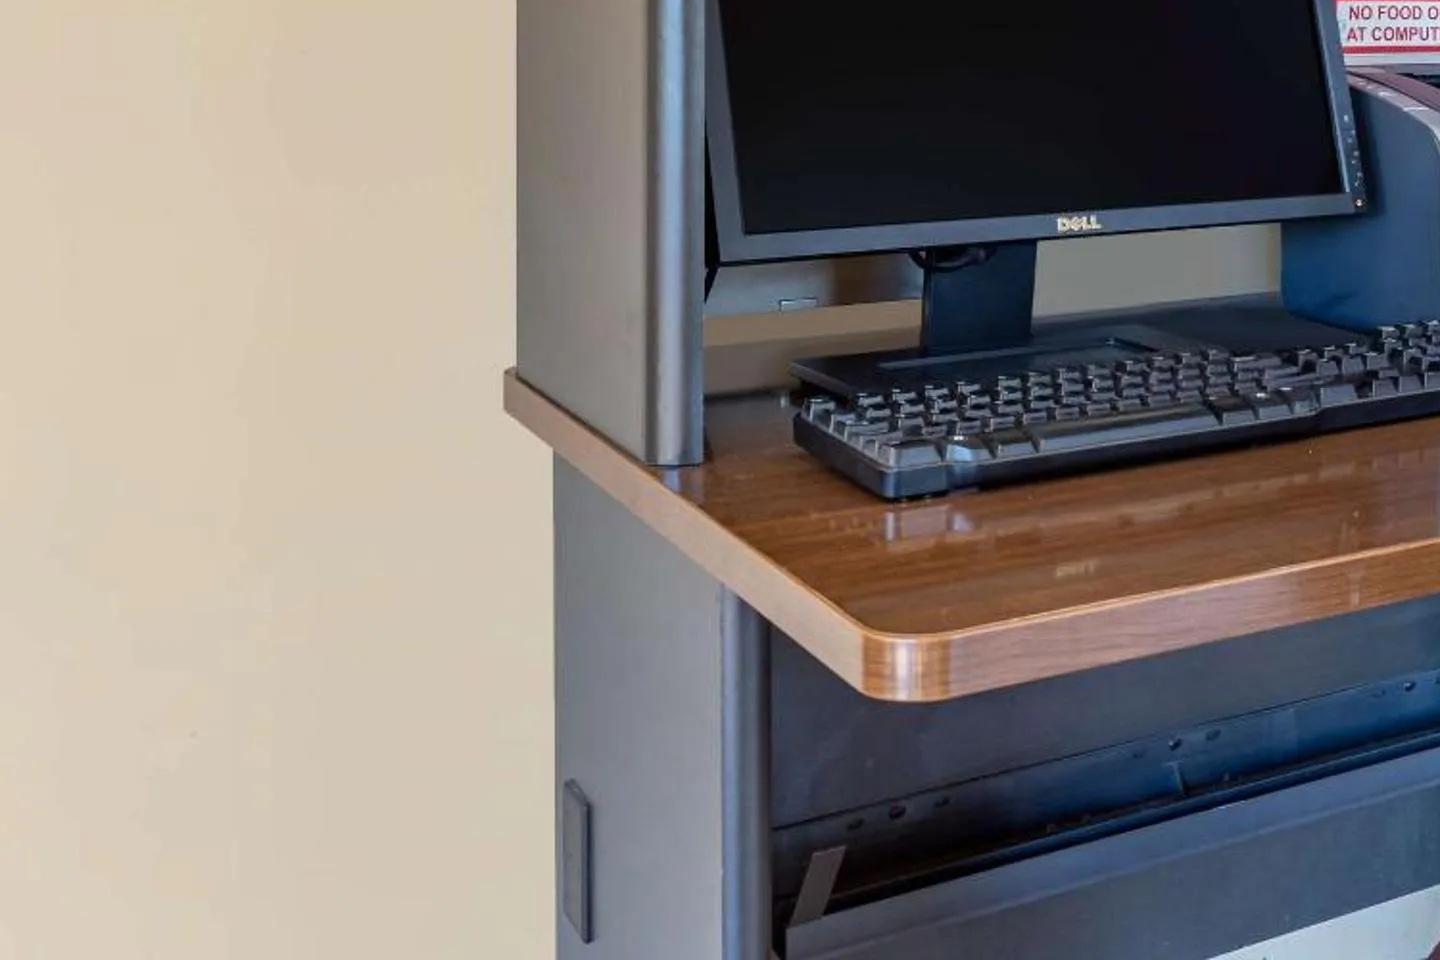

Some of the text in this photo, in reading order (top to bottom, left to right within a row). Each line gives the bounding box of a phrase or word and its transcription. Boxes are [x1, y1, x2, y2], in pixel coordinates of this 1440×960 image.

[1349, 5, 1373, 20] NO
[1378, 6, 1423, 20] FOOD
[1347, 26, 1367, 41] AT
[1056, 215, 1102, 232] DELL
